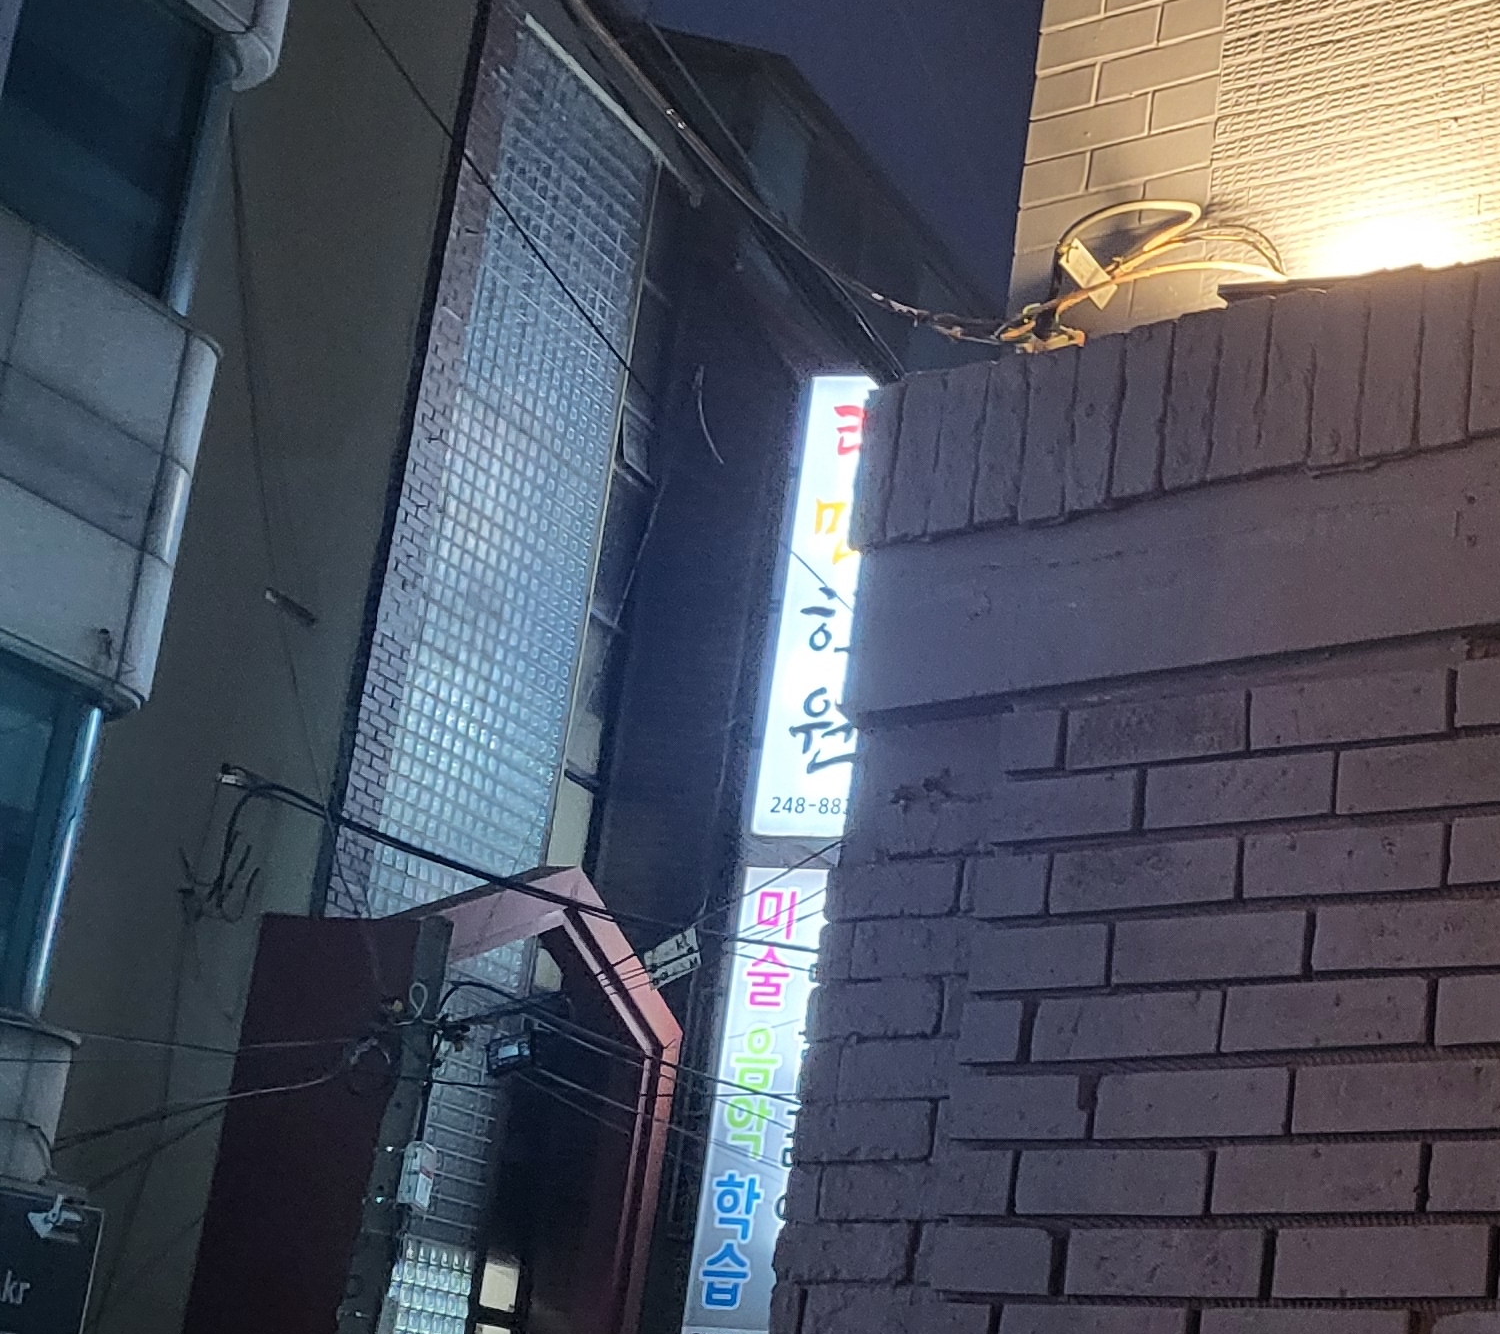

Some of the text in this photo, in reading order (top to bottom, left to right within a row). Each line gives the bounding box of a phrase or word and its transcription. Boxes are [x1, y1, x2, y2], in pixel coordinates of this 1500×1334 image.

[701, 890, 794, 1308] 미술 음악 학습
